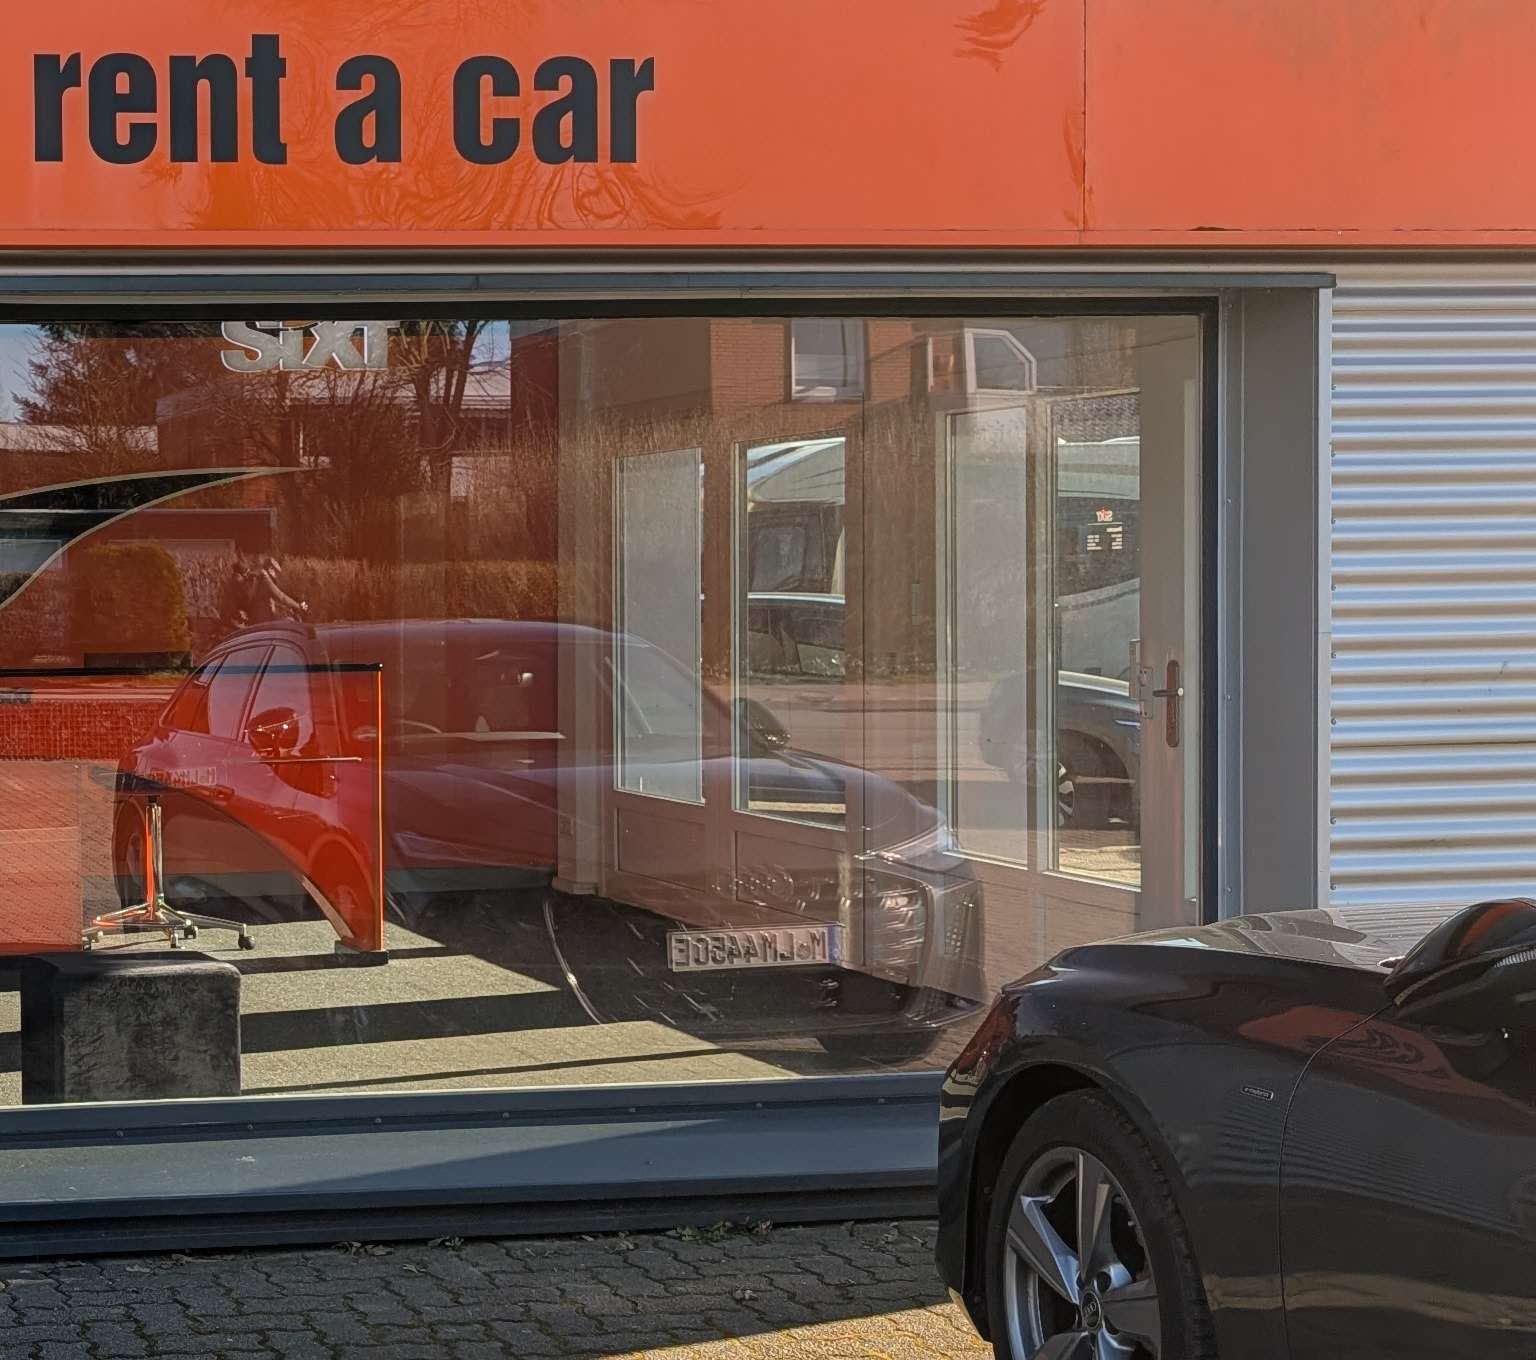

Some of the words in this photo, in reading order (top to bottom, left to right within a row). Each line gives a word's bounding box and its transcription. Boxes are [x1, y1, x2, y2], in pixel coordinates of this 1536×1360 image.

[32, 33, 288, 164] rent
[334, 53, 402, 163] a
[451, 54, 655, 164] car
